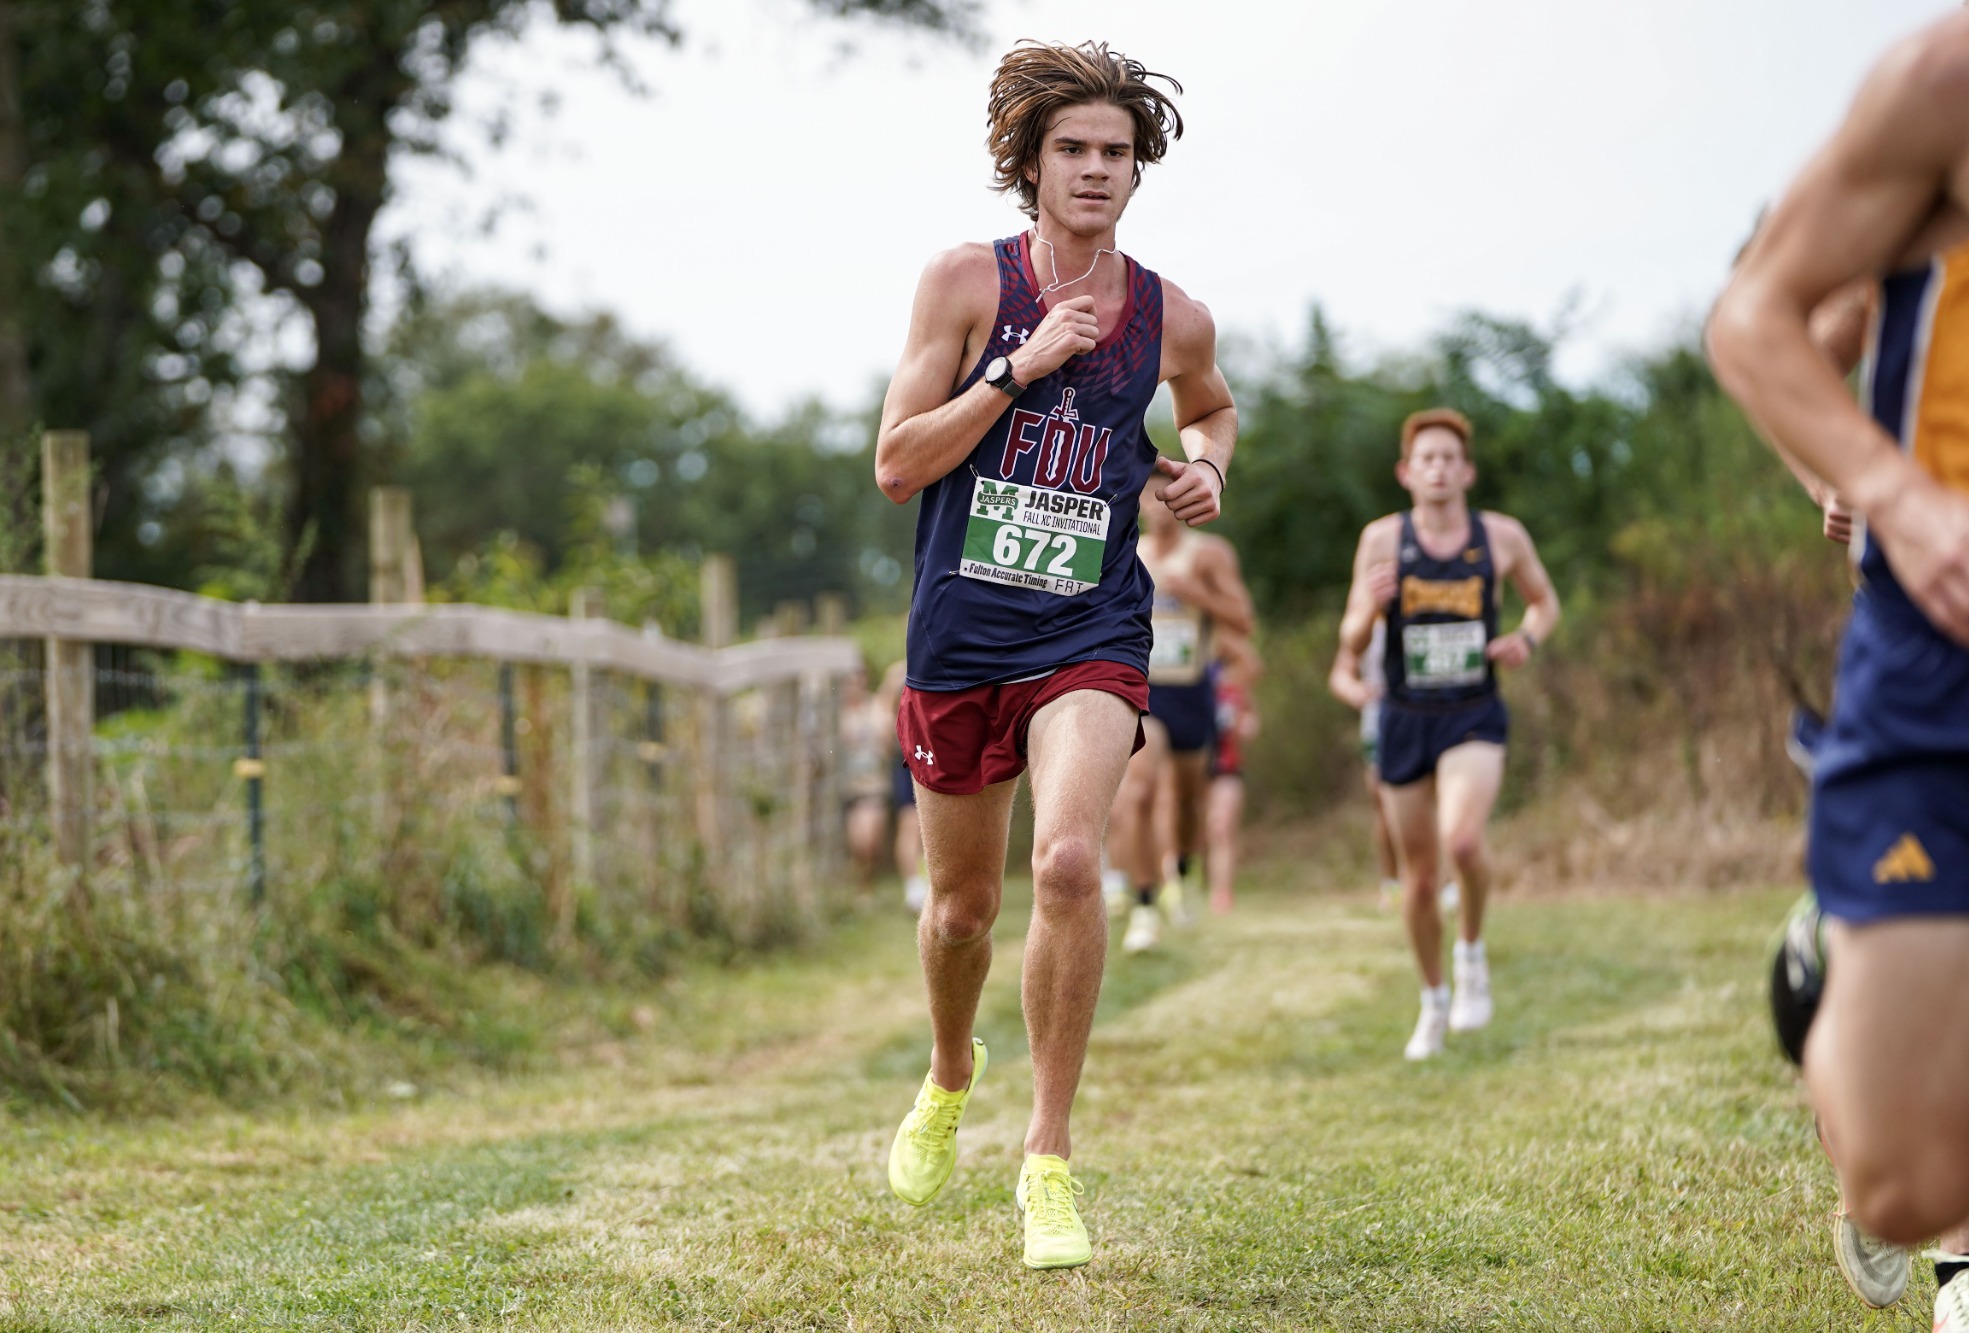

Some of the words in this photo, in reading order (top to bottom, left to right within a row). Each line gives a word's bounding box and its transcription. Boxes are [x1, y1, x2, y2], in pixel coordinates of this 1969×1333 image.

[1000, 405, 1113, 494] FDU
[979, 495, 1016, 506] JASPERS
[1024, 491, 1104, 521] JASPER
[1022, 510, 1040, 525] FALL
[1040, 515, 1051, 527] XC
[1050, 516, 1101, 536] INVITATIONAL
[993, 525, 1077, 577] 672
[968, 562, 992, 577] Fulton
[991, 567, 1023, 583] Accurate
[1023, 573, 1049, 589] Timing
